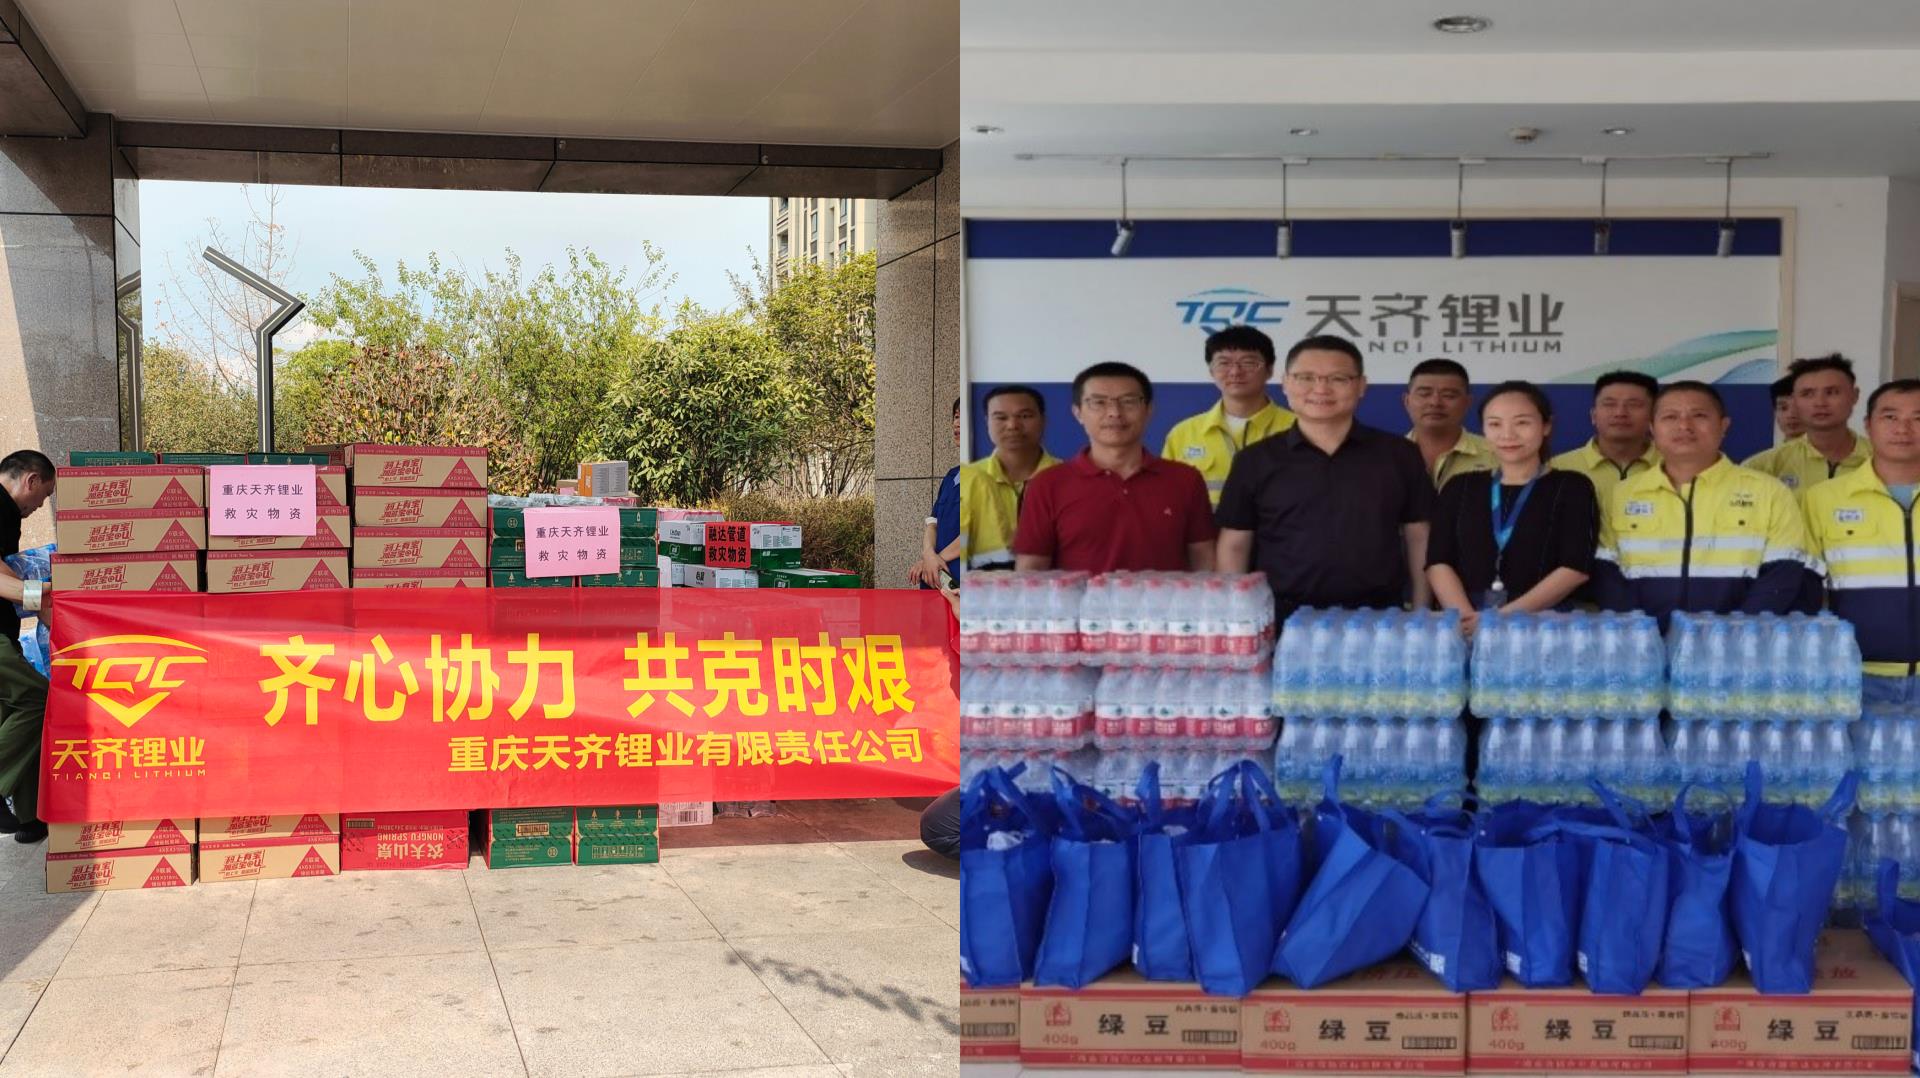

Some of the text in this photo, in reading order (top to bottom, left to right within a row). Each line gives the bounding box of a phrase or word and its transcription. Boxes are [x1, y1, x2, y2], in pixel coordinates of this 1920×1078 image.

[1305, 292, 1565, 338] 天齐锂业
[1443, 340, 1561, 353] LITHIUM
[222, 484, 303, 496] 重庆天齐锂业
[224, 507, 301, 520] 救灾物资
[536, 525, 609, 539] 重庆天齐锂业
[708, 526, 746, 542] 融达管道
[538, 548, 607, 562] 救灾物资
[709, 546, 746, 563] 救灾物资
[51, 656, 208, 694] TQC
[258, 631, 915, 727] 齐心协力 共克时艰
[52, 736, 206, 770] 天齐锂业
[448, 728, 923, 772] 重庆天齐锂业有限责任公司
[53, 769, 206, 782] TIANQI LITHIUM
[378, 832, 444, 841] NONGFU SPRING
[377, 843, 444, 860] 农夫山泉
[1098, 1013, 1170, 1036] 绿豆
[1319, 1019, 1391, 1041] 绿豆
[1545, 1019, 1617, 1041] 绿豆
[1767, 1019, 1840, 1041] 绿豆
[1042, 1033, 1079, 1046] 400g
[1260, 1039, 1297, 1051] 400g
[1488, 1038, 1526, 1050] 400g
